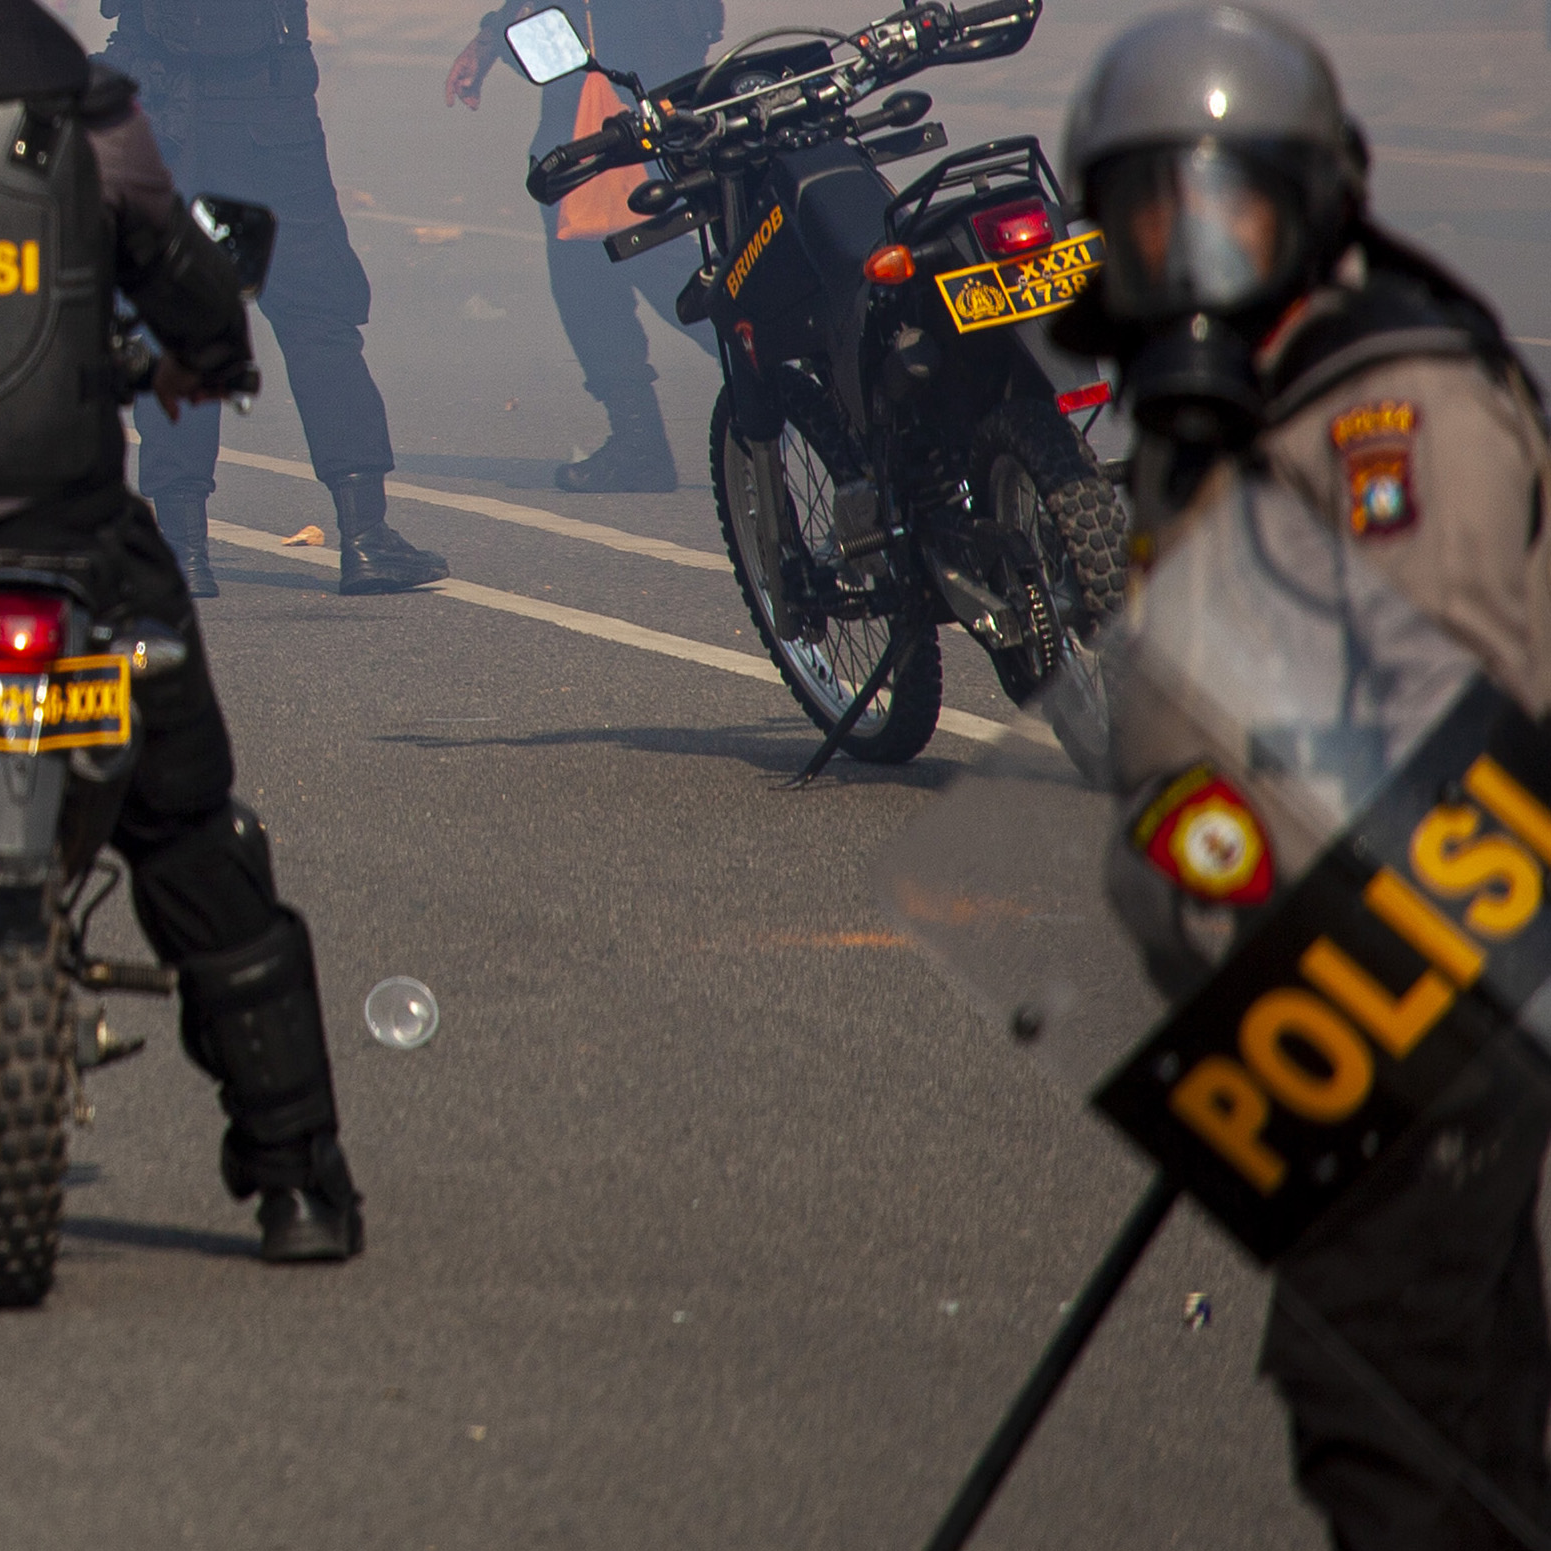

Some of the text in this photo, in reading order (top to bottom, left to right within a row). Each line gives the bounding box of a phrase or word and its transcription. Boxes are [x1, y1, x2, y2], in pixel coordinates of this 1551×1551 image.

[726, 204, 784, 299] BRIMOB
[1017, 243, 1091, 280] XXXI
[1020, 273, 1091, 308] 1738
[1168, 752, 1551, 1196] POLISI
